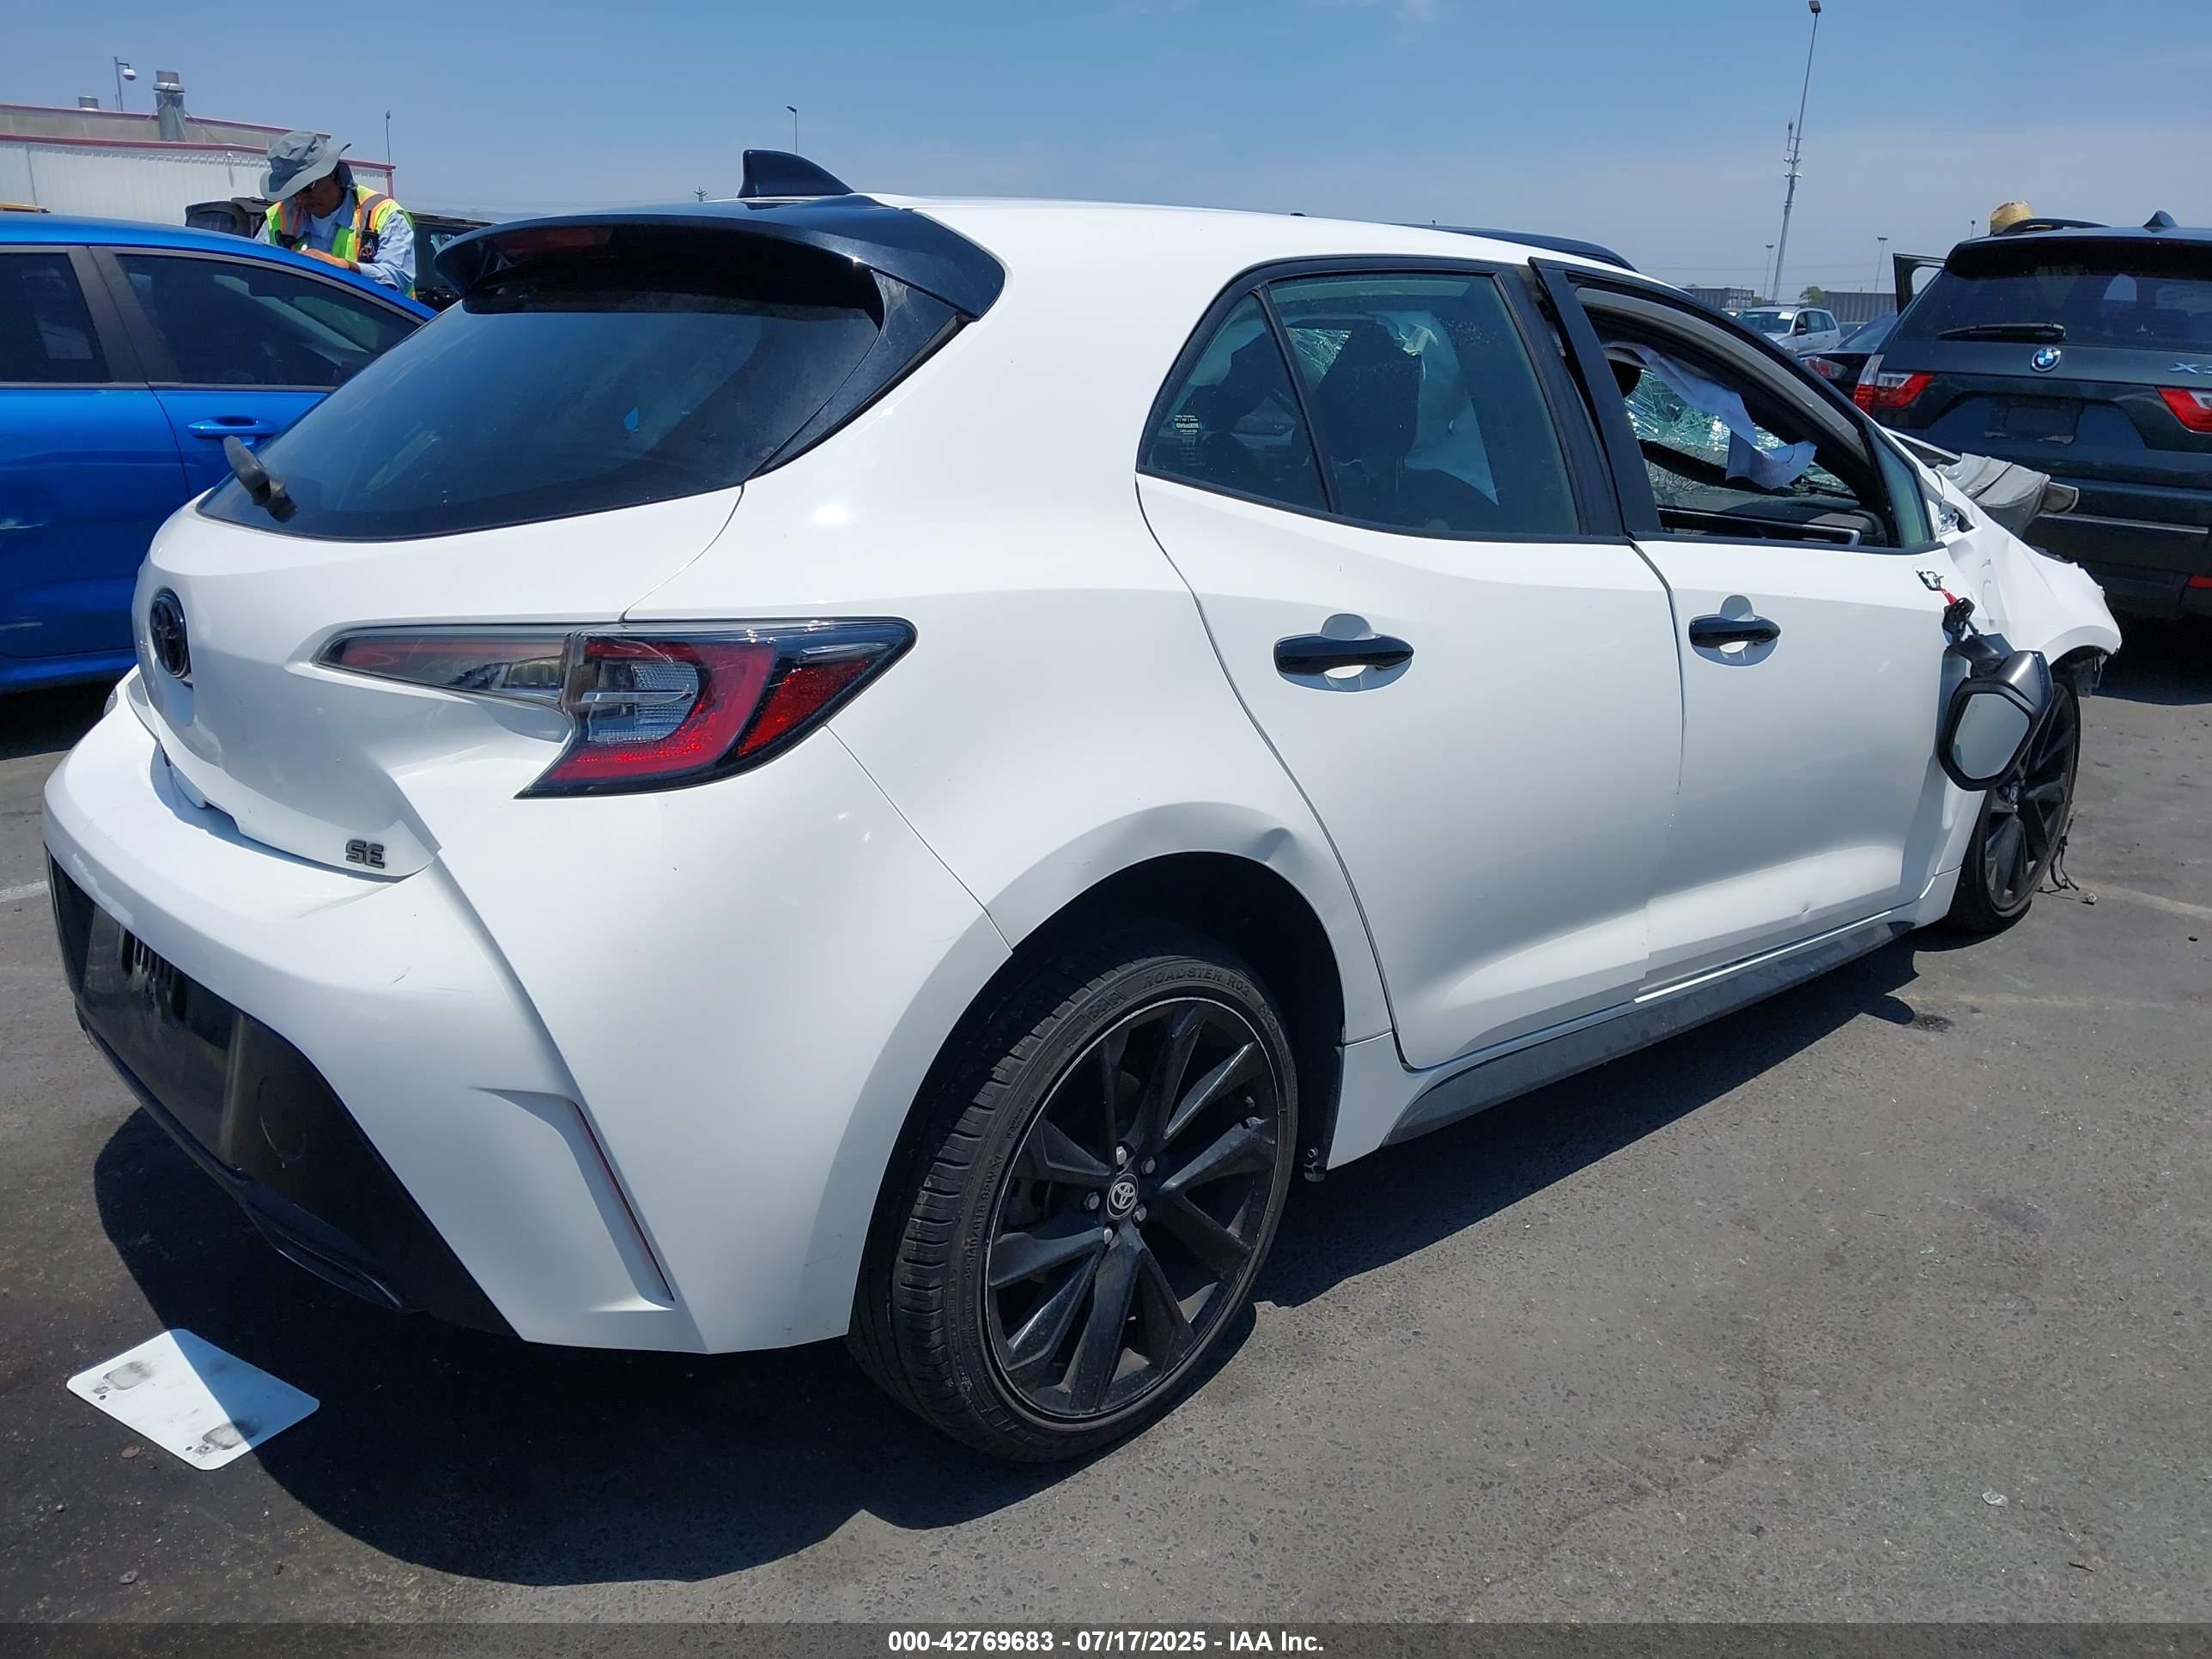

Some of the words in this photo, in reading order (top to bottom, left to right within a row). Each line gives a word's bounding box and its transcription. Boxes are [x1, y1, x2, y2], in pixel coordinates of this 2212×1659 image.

[345, 839, 386, 869] SE
[1144, 967, 1224, 988] ROADSTER
[1226, 973, 1251, 997] R02
